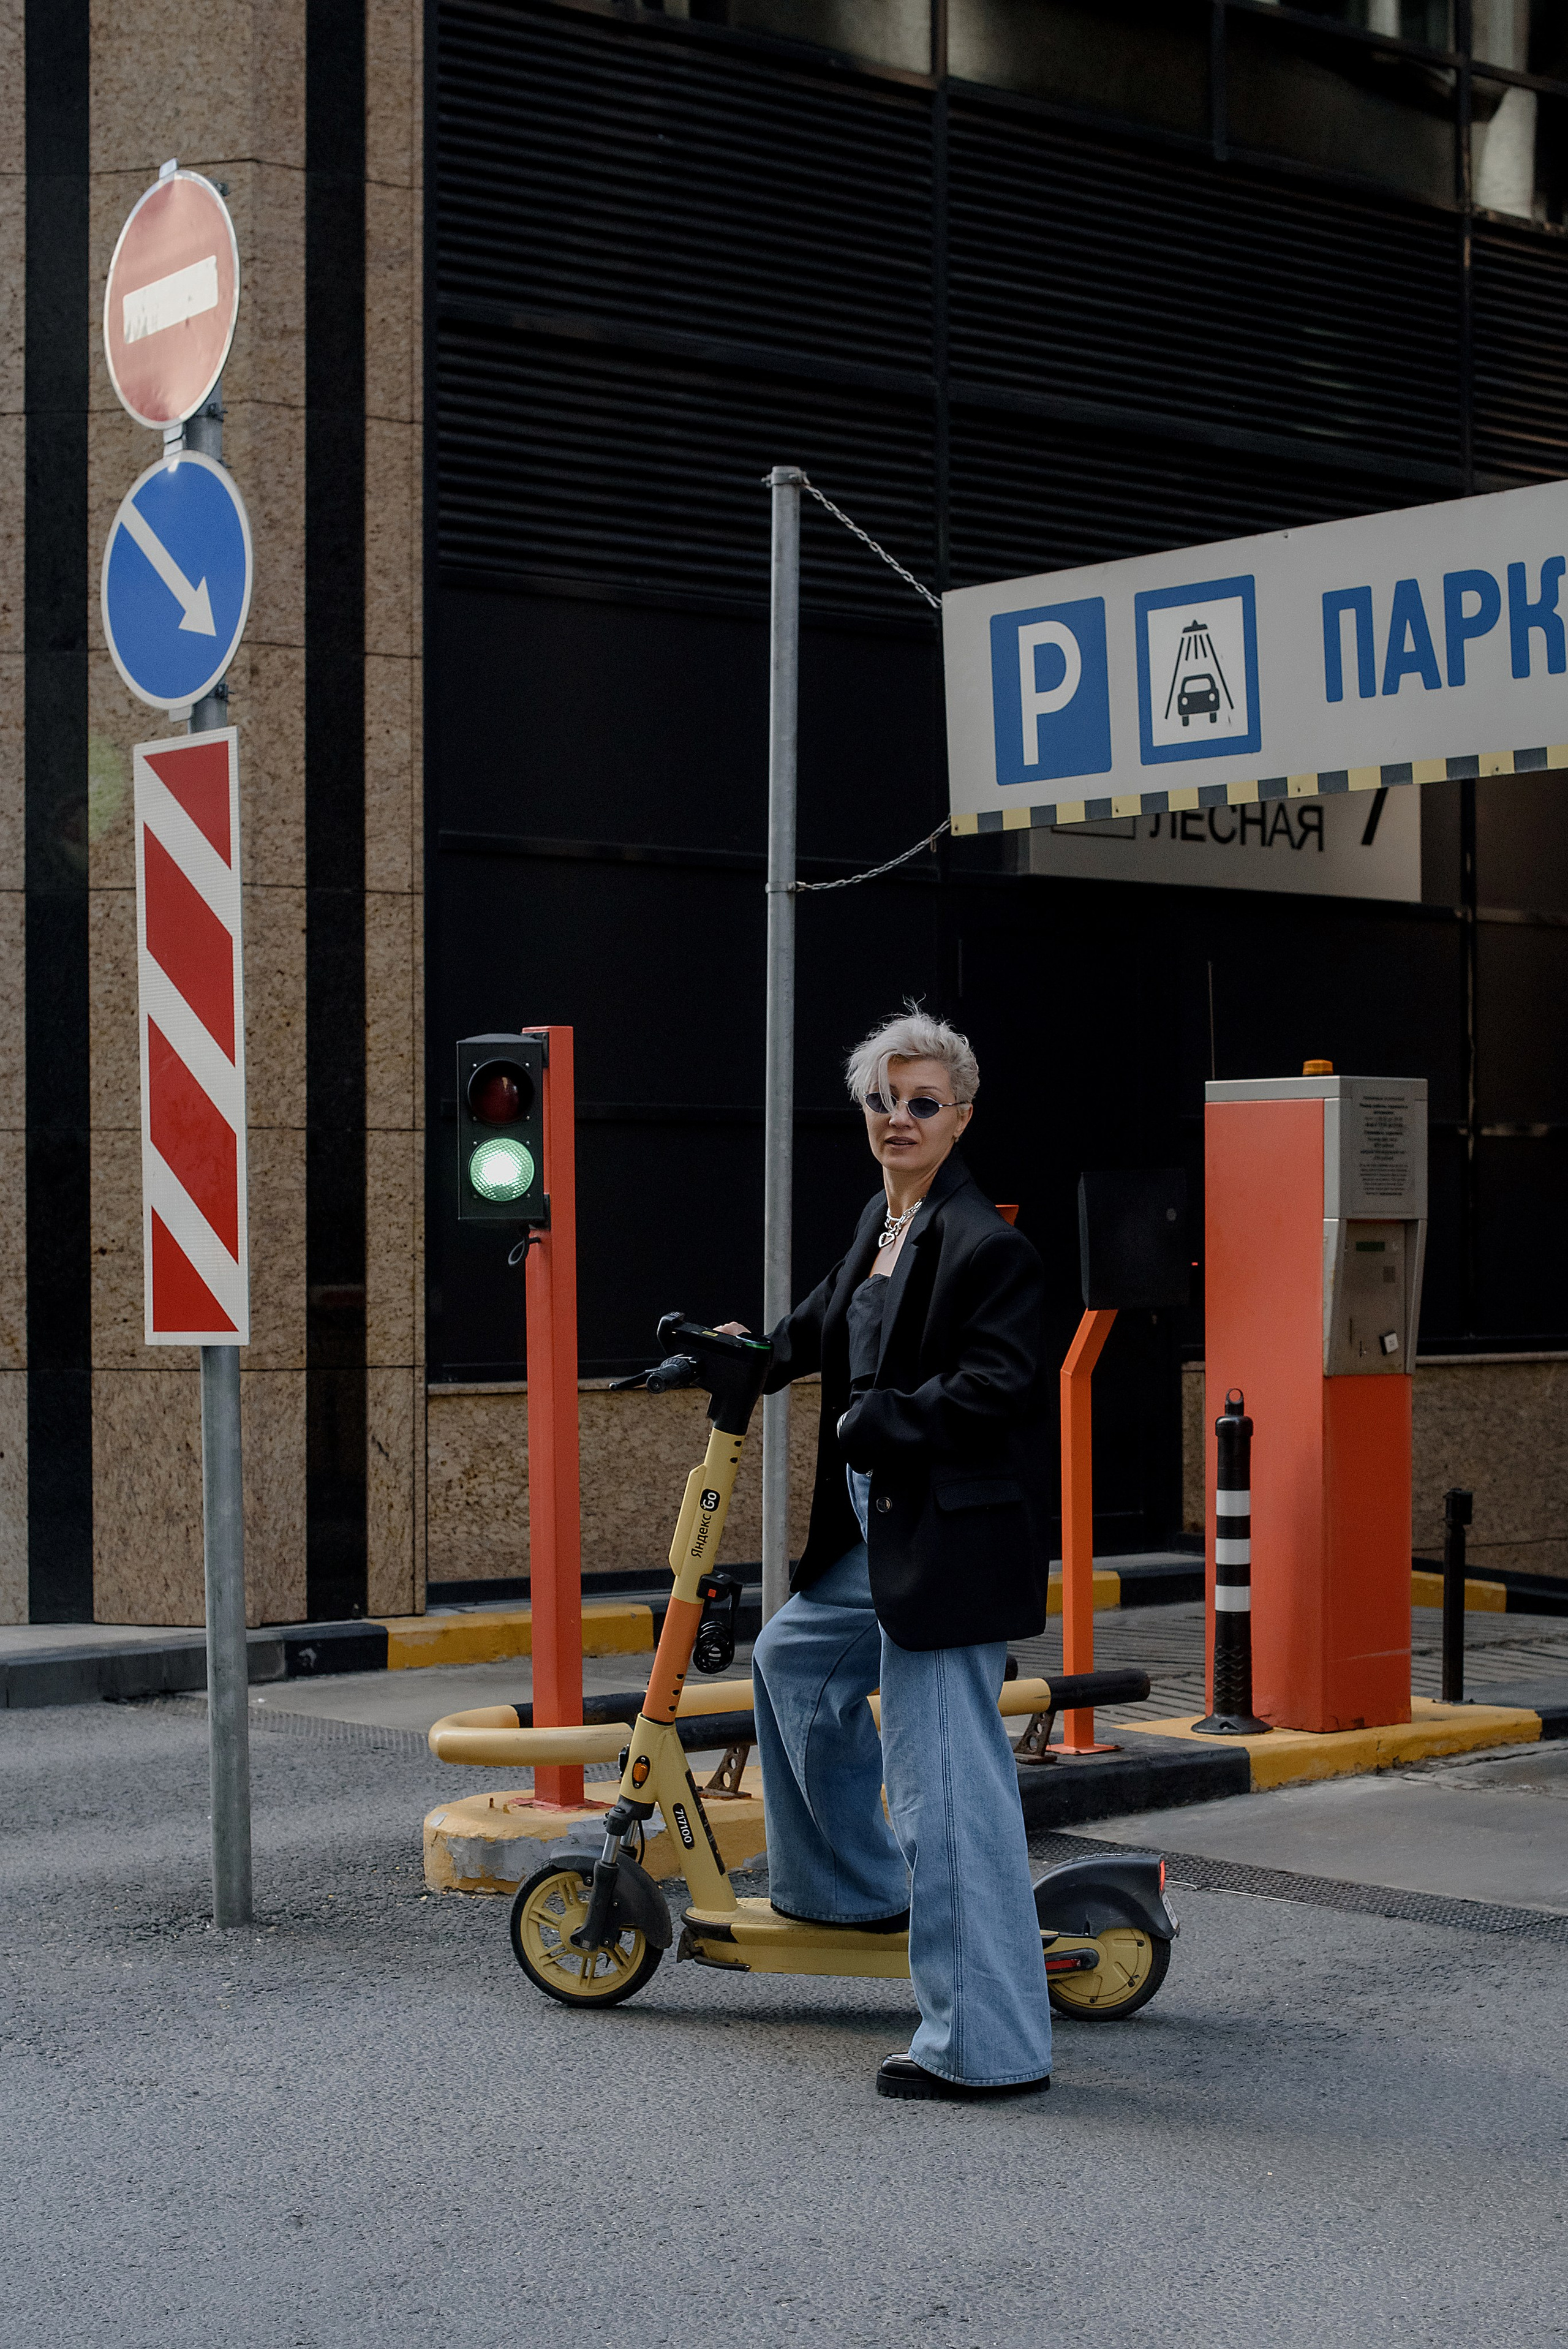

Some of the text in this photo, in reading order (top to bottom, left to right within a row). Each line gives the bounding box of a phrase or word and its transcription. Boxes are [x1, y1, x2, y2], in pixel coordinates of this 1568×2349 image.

[1322, 556, 1566, 703] ПАРК
[1017, 620, 1082, 766] P
[690, 1492, 717, 1558] Яндекс Go
[675, 1809, 692, 1843] 717100
